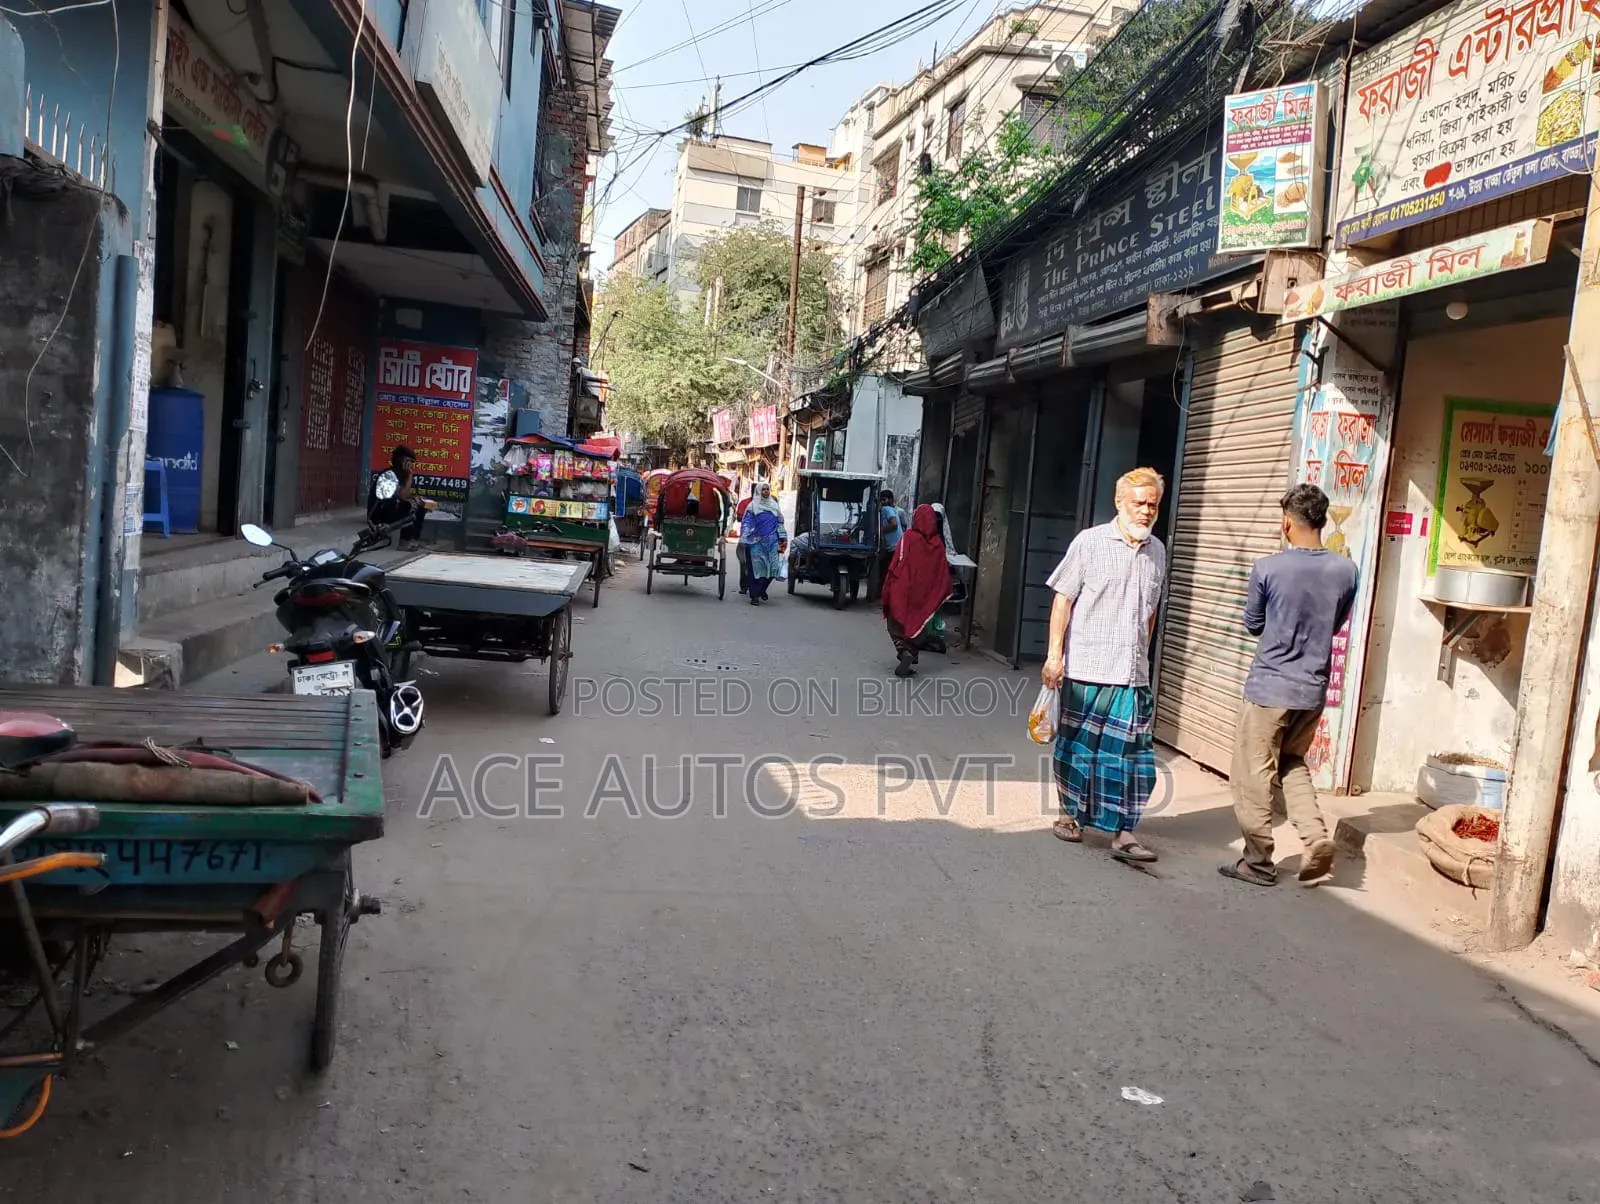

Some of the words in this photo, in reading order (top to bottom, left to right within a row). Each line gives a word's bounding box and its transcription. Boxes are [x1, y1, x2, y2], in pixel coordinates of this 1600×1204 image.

[1357, 38, 1440, 124] ফরাজী
[1448, 0, 1600, 79] এন্টারপ্রা
[1487, 70, 1517, 93] মরিচ
[1230, 93, 1277, 128] ফরাজী
[1282, 91, 1312, 122] মিল
[1471, 125, 1494, 146] করা
[1496, 116, 1516, 136] হয়
[1400, 175, 1422, 193] এবং
[1500, 138, 1519, 158] হয়
[1390, 190, 1447, 222] 01705231250
[1041, 266, 1069, 289] THE
[1149, 184, 1216, 239] STEEL
[1333, 260, 1417, 303] ফরাজী
[1427, 243, 1487, 281] মিল
[379, 347, 421, 388] সিটি
[1497, 419, 1536, 449] ফরাজী
[1333, 449, 1369, 497] মিল
